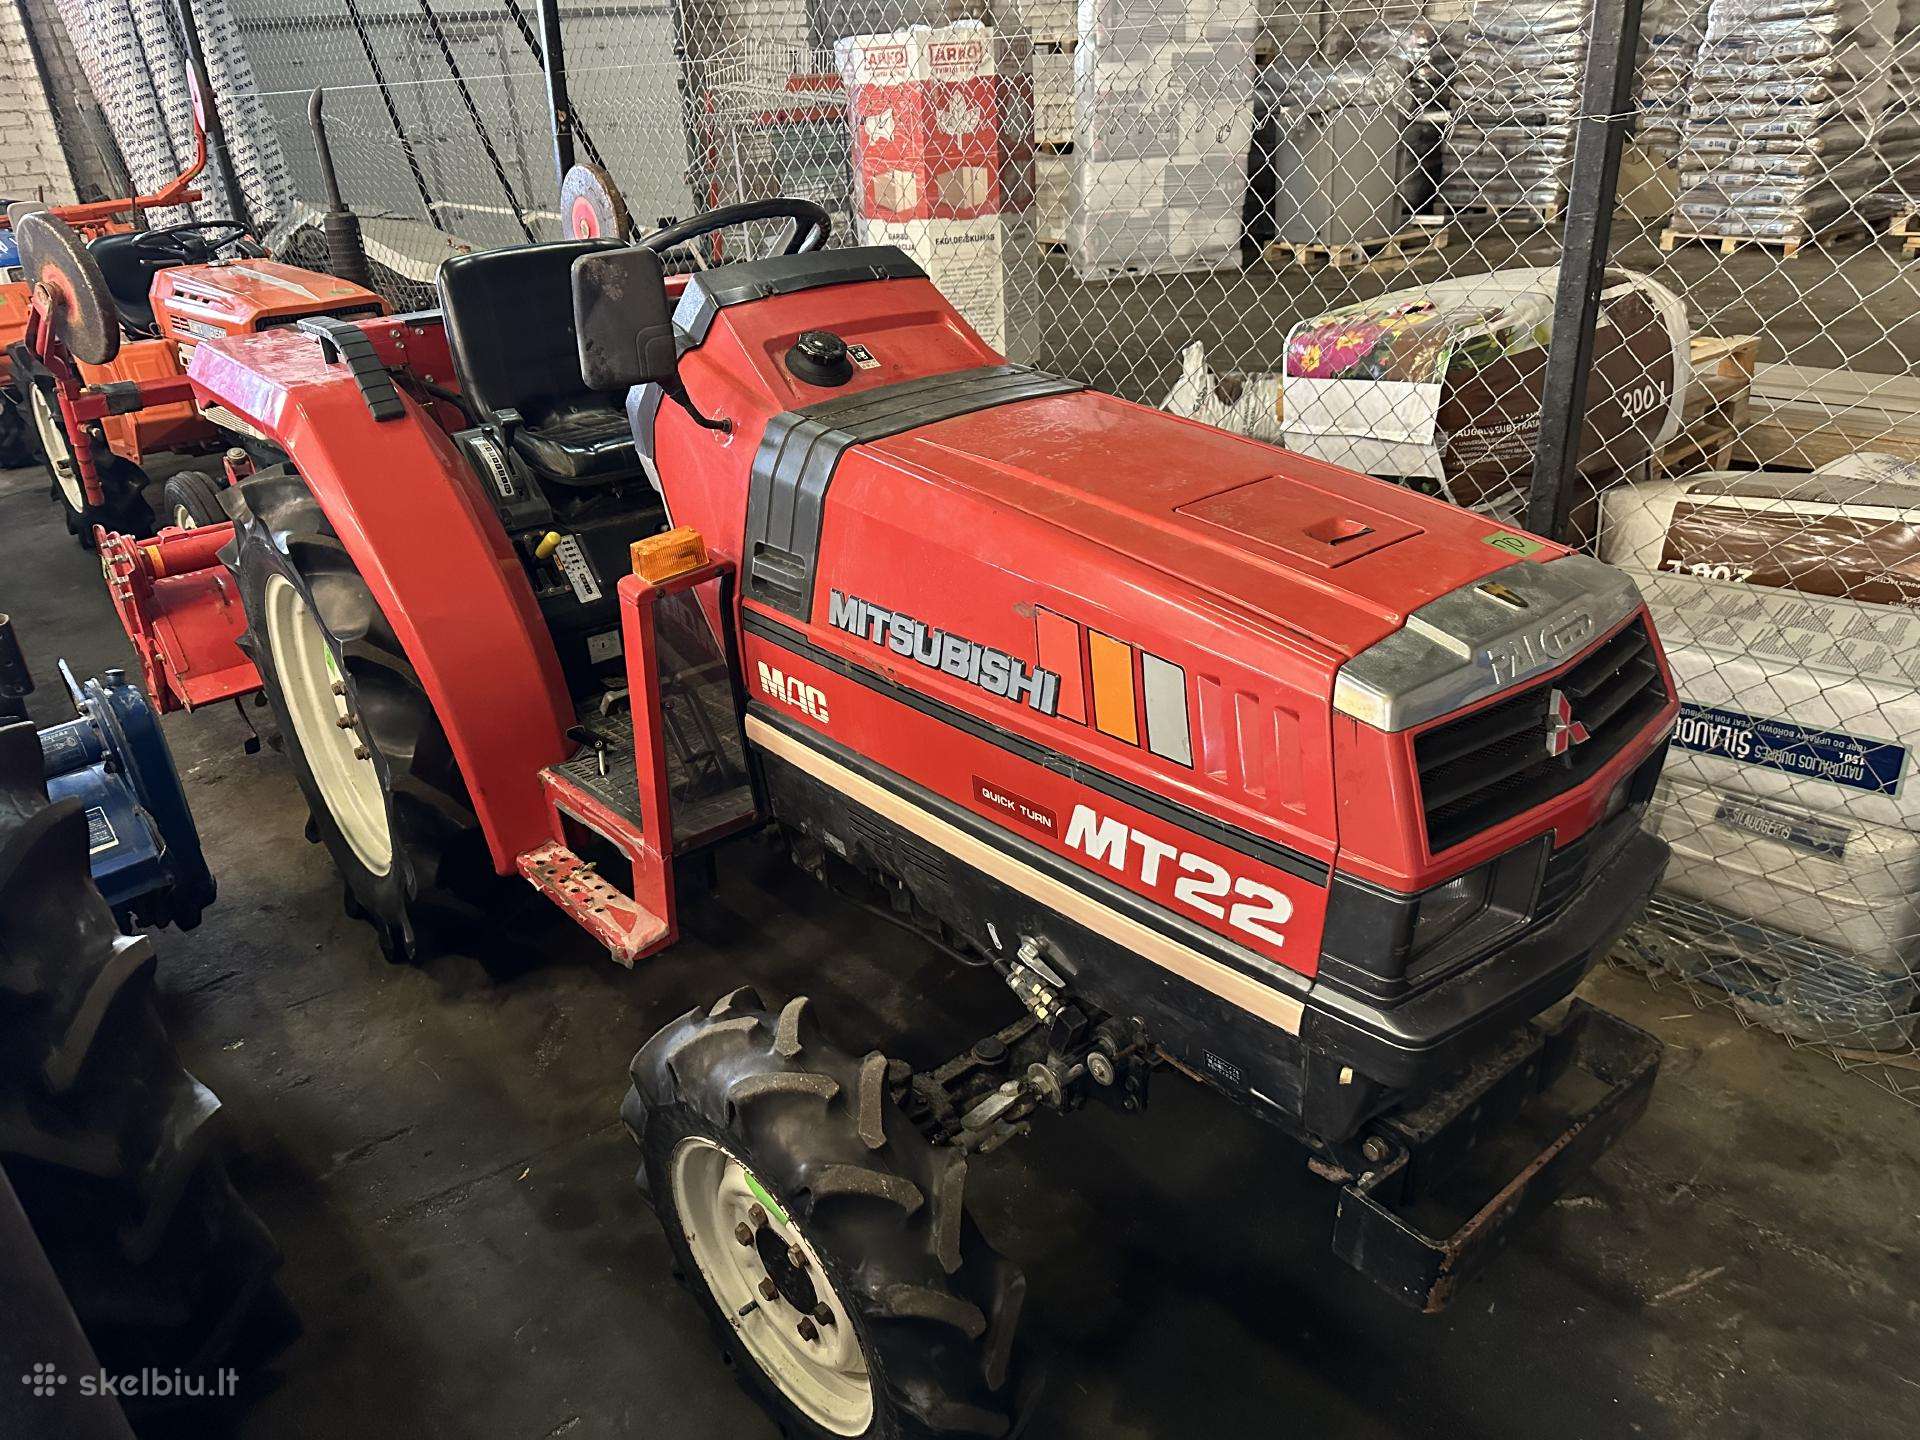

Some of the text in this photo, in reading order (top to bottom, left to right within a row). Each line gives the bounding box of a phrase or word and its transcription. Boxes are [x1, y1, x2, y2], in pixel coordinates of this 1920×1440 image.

[933, 44, 979, 62] ARKO
[1621, 384, 1655, 418] 200
[829, 588, 1061, 717] MITSUBISHI
[757, 659, 829, 724] MAC
[1714, 714, 1731, 724] FOR
[1731, 719, 1751, 728] PEAT
[1832, 740, 1845, 748] DO
[1844, 753, 1866, 765] 150
[982, 787, 1052, 828] QUICK TURN
[1064, 804, 1293, 947] MT22
